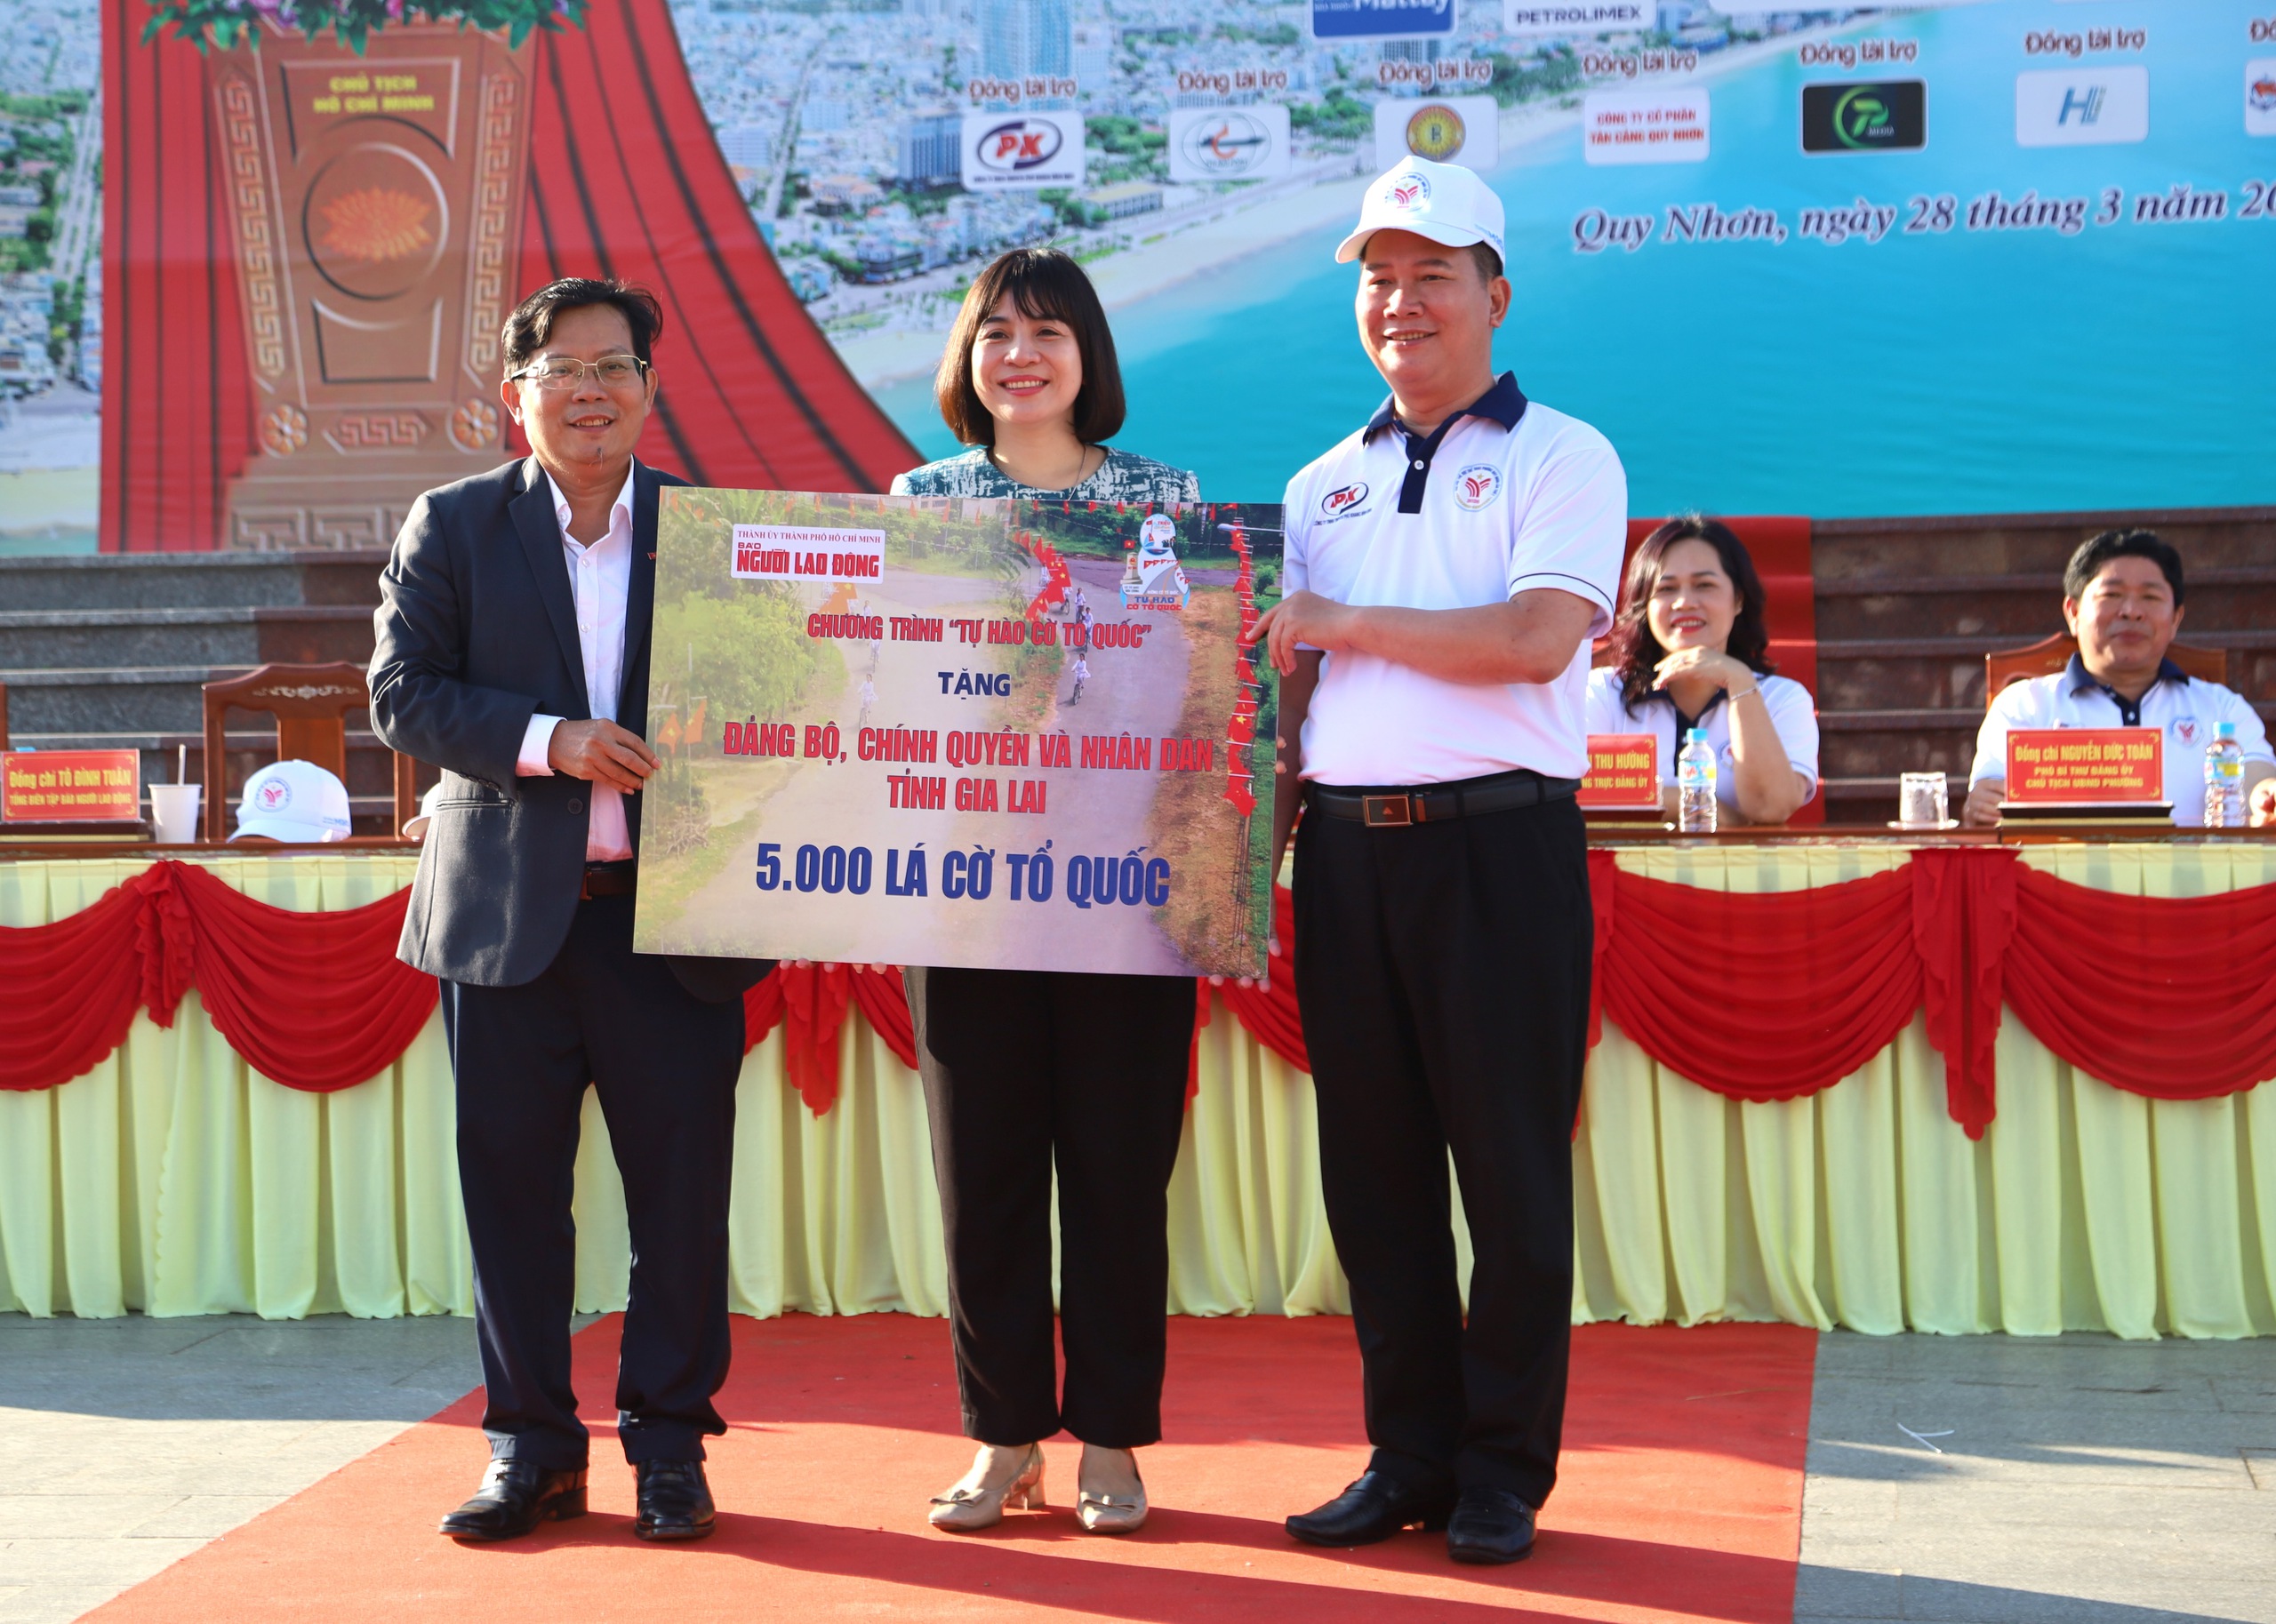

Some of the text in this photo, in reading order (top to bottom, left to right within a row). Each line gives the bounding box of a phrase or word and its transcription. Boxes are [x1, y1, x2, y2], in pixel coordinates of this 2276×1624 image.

[1518, 6, 1641, 25] PETROLIMEX
[374, 75, 418, 95] TỊCH
[382, 94, 436, 112] MINH
[1598, 110, 1627, 125] CÔNG
[1632, 111, 1643, 124] TY
[1591, 130, 1612, 145] TÂN
[1649, 131, 1669, 143] QUY
[1673, 128, 1704, 140] NHƠN
[1869, 125, 1895, 137] MEDIA
[1575, 208, 1653, 252] Quy
[1663, 204, 1788, 244] Nhơn,
[1800, 197, 1895, 244] ngày
[1905, 195, 1957, 234] 28
[1967, 189, 2088, 236] tháng
[2096, 187, 2123, 225] 3
[2135, 183, 2227, 223] năm
[737, 530, 765, 540] THÀNH
[781, 532, 808, 541] THÀNH
[829, 532, 841, 542] HỒ
[842, 533, 857, 543] CHÍ
[859, 535, 881, 544] MINH
[737, 541, 762, 549] BÁO
[737, 548, 880, 578] NGƯỜI LAO ĐỘNG
[807, 613, 883, 640] CHƯƠNG
[890, 613, 942, 643] TRÌNH
[988, 616, 1025, 645] HÀO
[1031, 617, 1058, 647] CỜ
[938, 668, 1011, 700] TẶNG
[723, 715, 1214, 772] ĐẢNG BỘ, CHÍNH QUYỀN VÀ NHÂN DÂN
[2015, 739, 2154, 764] Đồng chí NGUYỄN ĐỨC TOÀN
[1595, 754, 1614, 770] THU
[2034, 764, 2055, 776] PHÓ
[2056, 764, 2068, 776] BÍ
[2070, 765, 2089, 776] THƯ
[9, 769, 37, 790] Đồng
[1594, 776, 1614, 790] TRỰC
[1615, 774, 1637, 788] ĐẢNG
[1638, 774, 1649, 788] ỦY
[2025, 776, 2144, 790] CHỦ TỊCH UBND PHƯỜNG
[887, 767, 1046, 815] TỈNH GIA LAI
[756, 839, 1170, 909] 5.000 LÁ CỜ TỔ QUỐC
